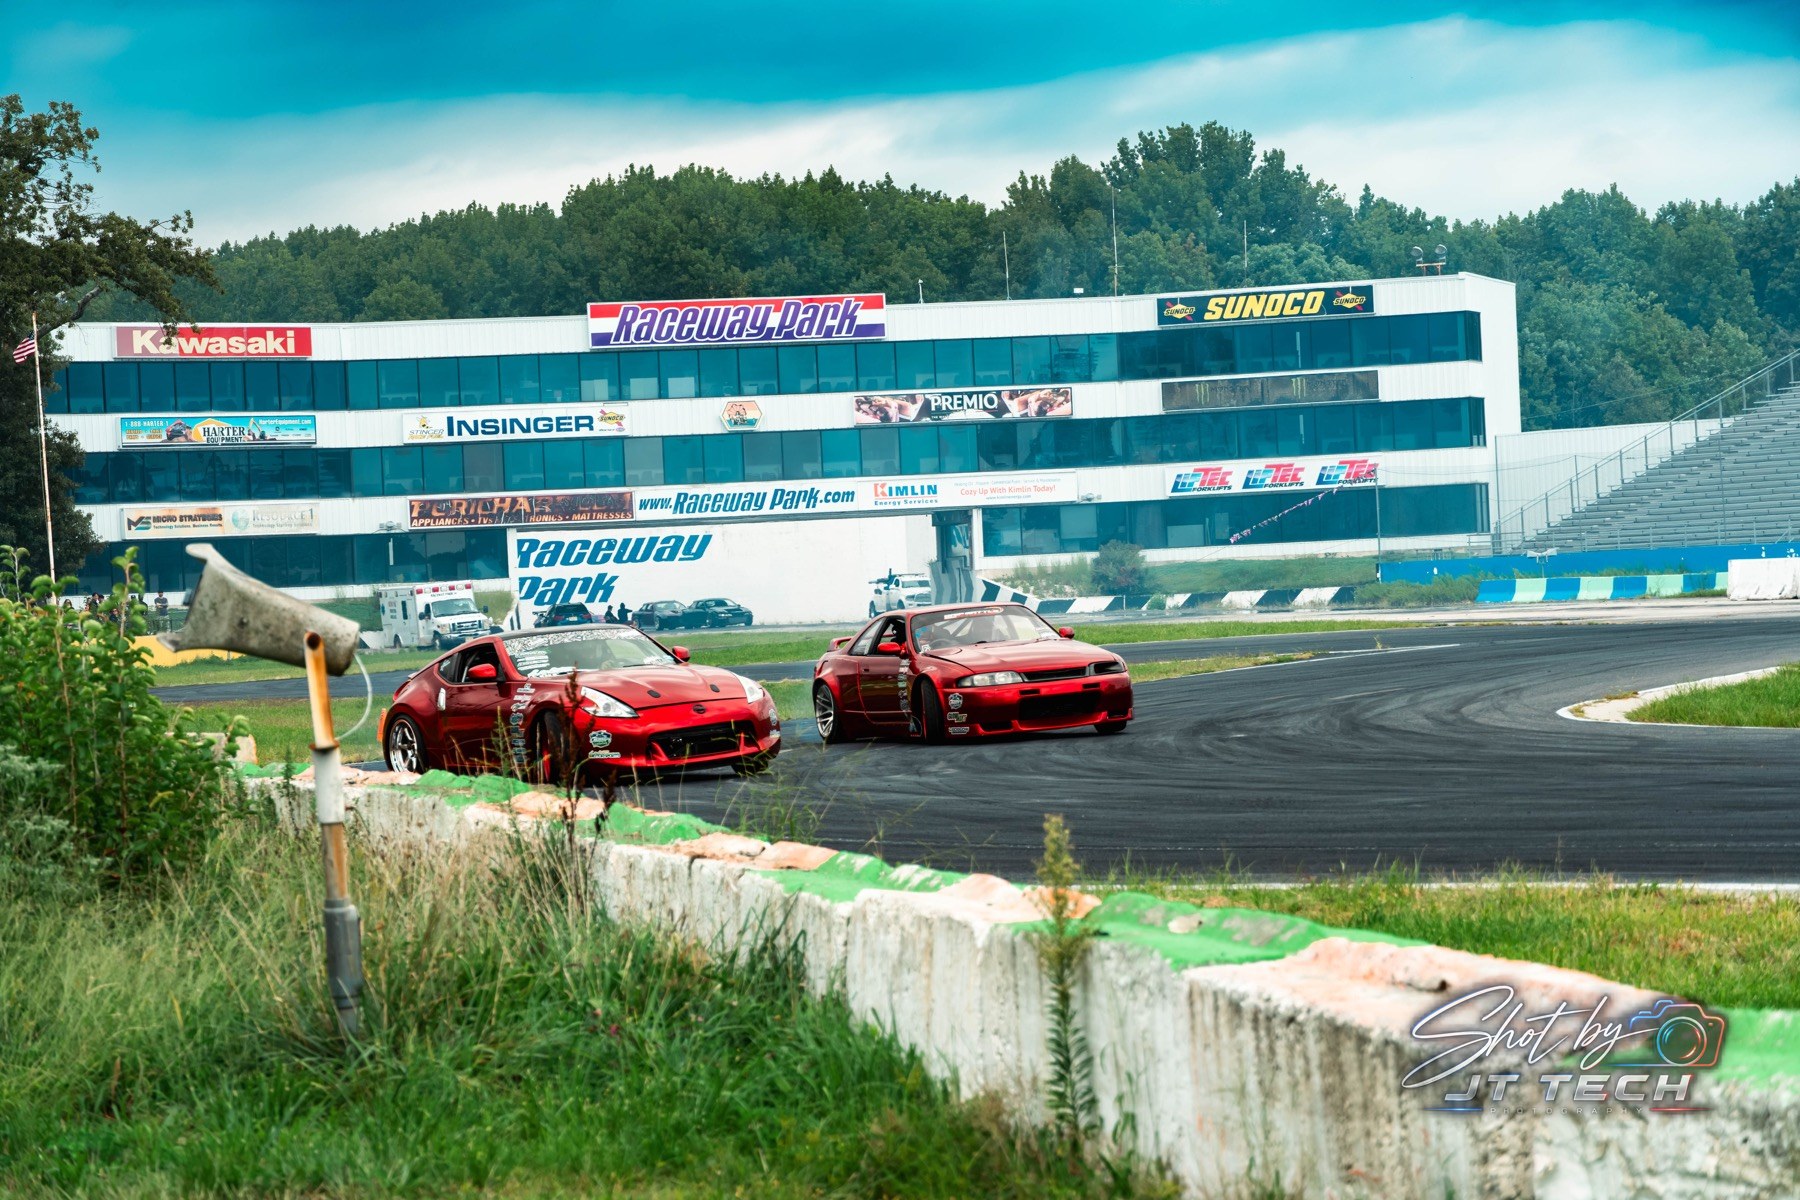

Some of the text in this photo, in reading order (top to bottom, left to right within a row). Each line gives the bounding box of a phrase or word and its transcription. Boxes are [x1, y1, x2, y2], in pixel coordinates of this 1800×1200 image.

[1203, 291, 1325, 320] SUNOCO
[1334, 296, 1365, 305] SUNOCO
[1165, 306, 1195, 316] SUNOCO
[610, 298, 864, 345] Raceway Park
[132, 329, 296, 355] Kawasaki
[931, 393, 998, 411] PREMIO
[202, 426, 246, 437] HARTER
[446, 415, 594, 437] INSINGER
[874, 483, 938, 497] KIMLIN
[960, 484, 1056, 496] Cozy Up With Kimlin Today!
[1263, 481, 1305, 489] FORKLIFTS
[152, 513, 223, 523] MICRO STRATEGIES
[411, 517, 469, 527] APPLIANCES
[571, 511, 633, 521] MATTRESSES
[516, 534, 713, 568] Raceway
[518, 572, 620, 606] Park
